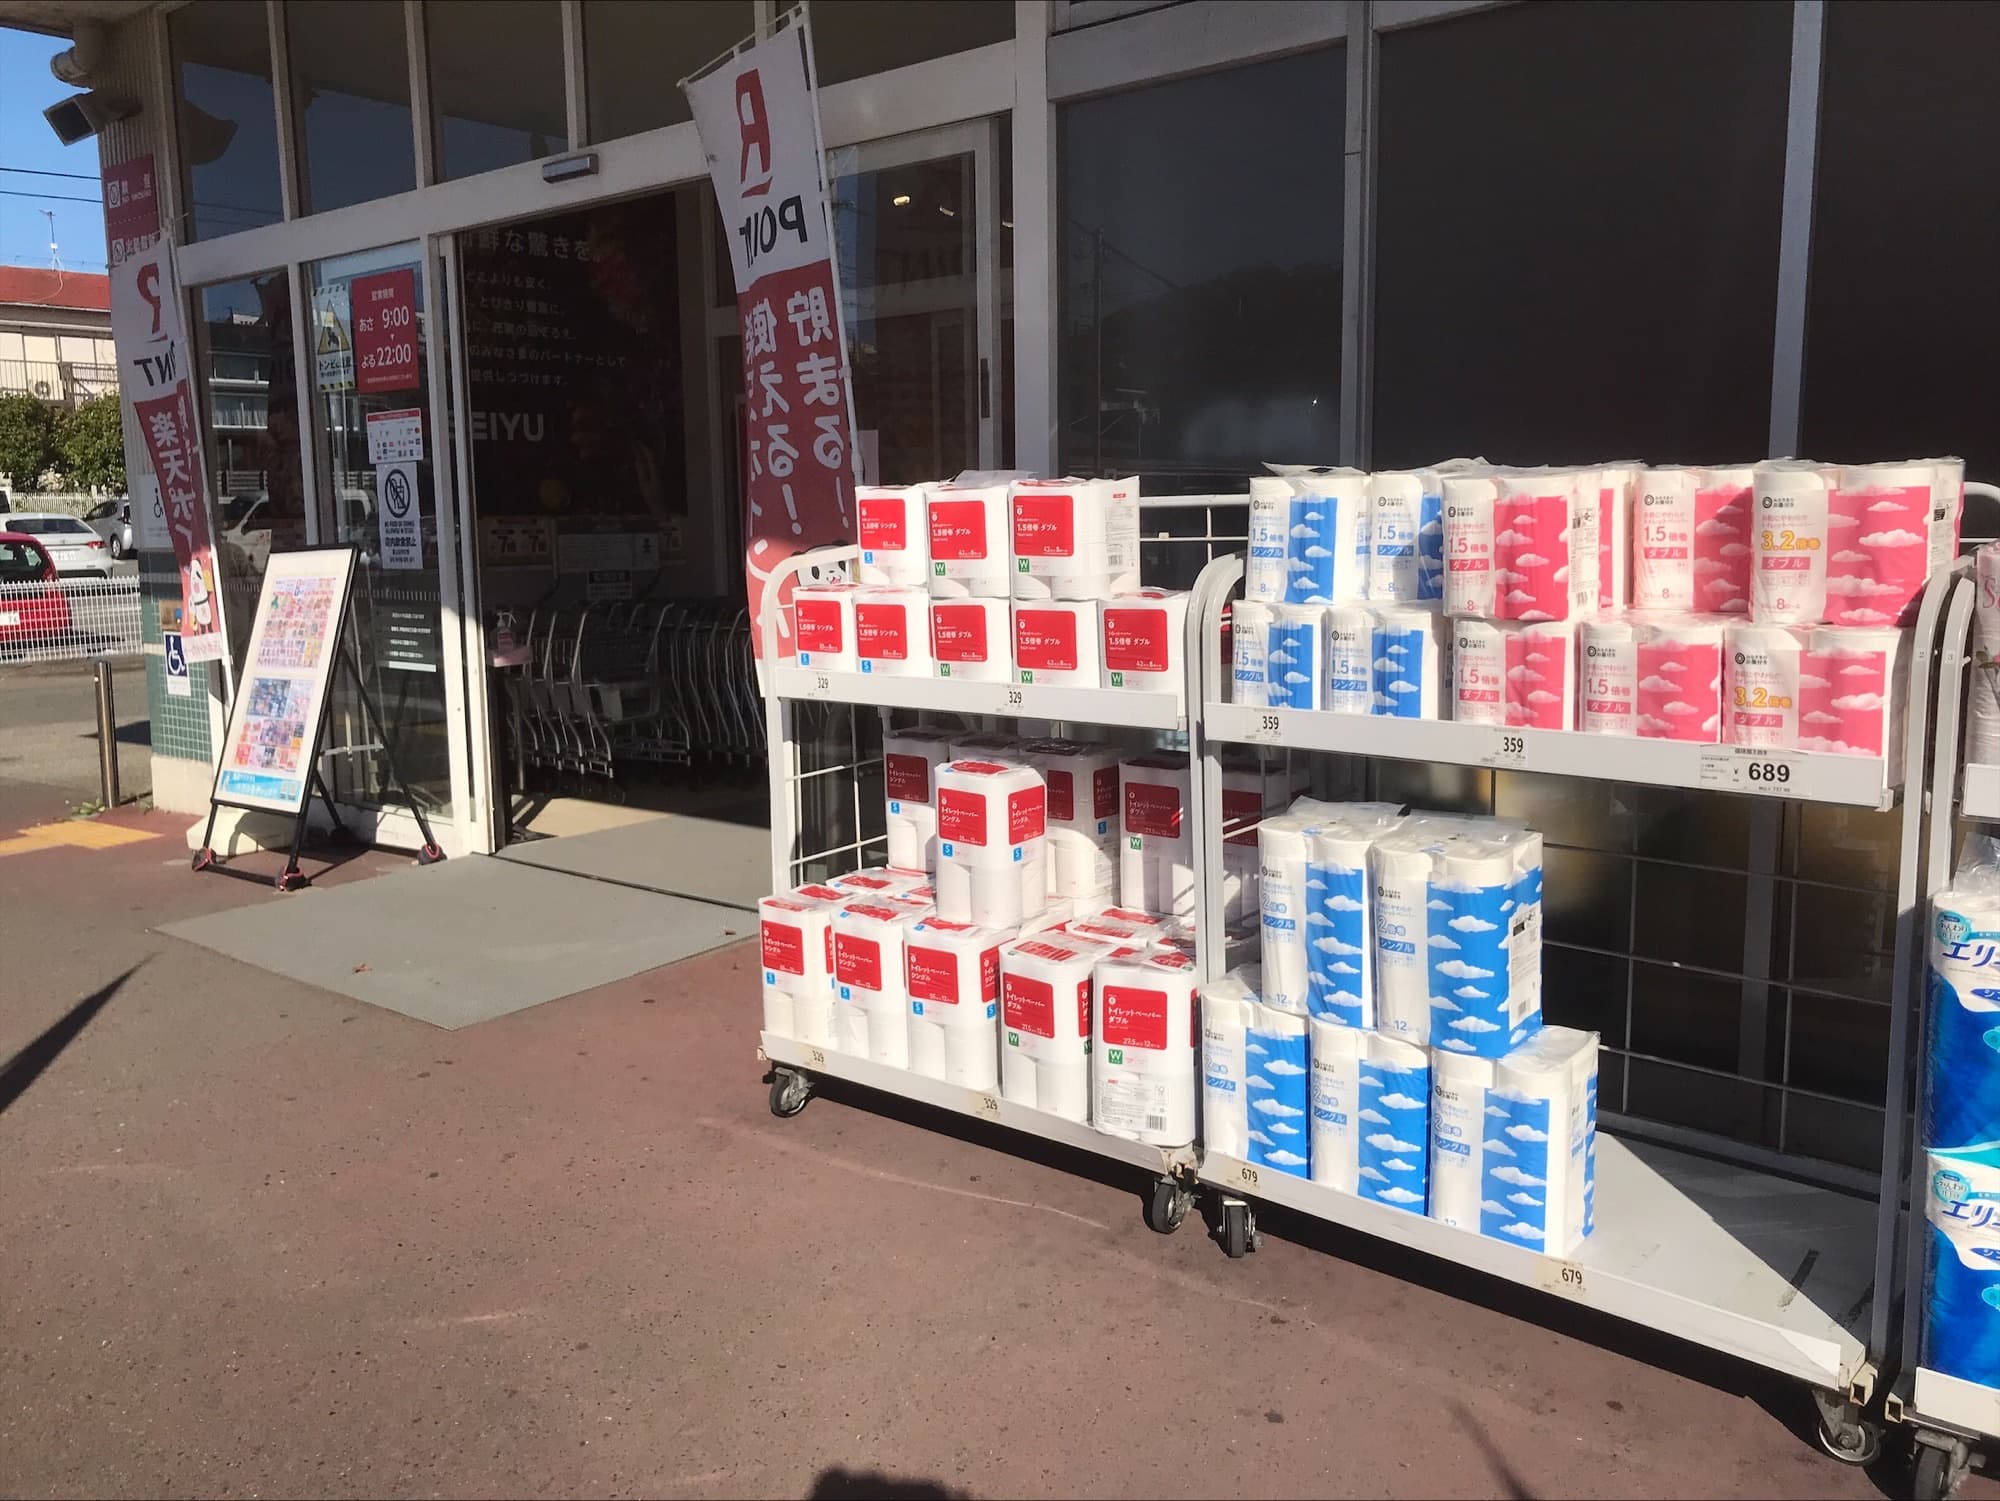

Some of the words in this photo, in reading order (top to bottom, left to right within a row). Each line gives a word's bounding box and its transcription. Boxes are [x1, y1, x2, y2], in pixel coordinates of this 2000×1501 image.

[360, 317, 374, 332] あさ
[382, 305, 410, 328] 9:00
[361, 355, 376, 369] よる
[377, 343, 411, 367] 22:00
[1767, 558, 1804, 569] ダブル
[818, 676, 829, 689] 329
[1009, 691, 1022, 704] 329
[1463, 691, 1495, 700] ダブル
[1591, 702, 1625, 712] ダブル
[1262, 716, 1279, 730] 359
[1503, 736, 1524, 753] 359
[1748, 762, 1791, 783] 689
[1276, 994, 1287, 1003] 12
[1394, 1021, 1407, 1031] 12
[1242, 1167, 1258, 1182] 679
[1562, 1267, 1583, 1284] 679
